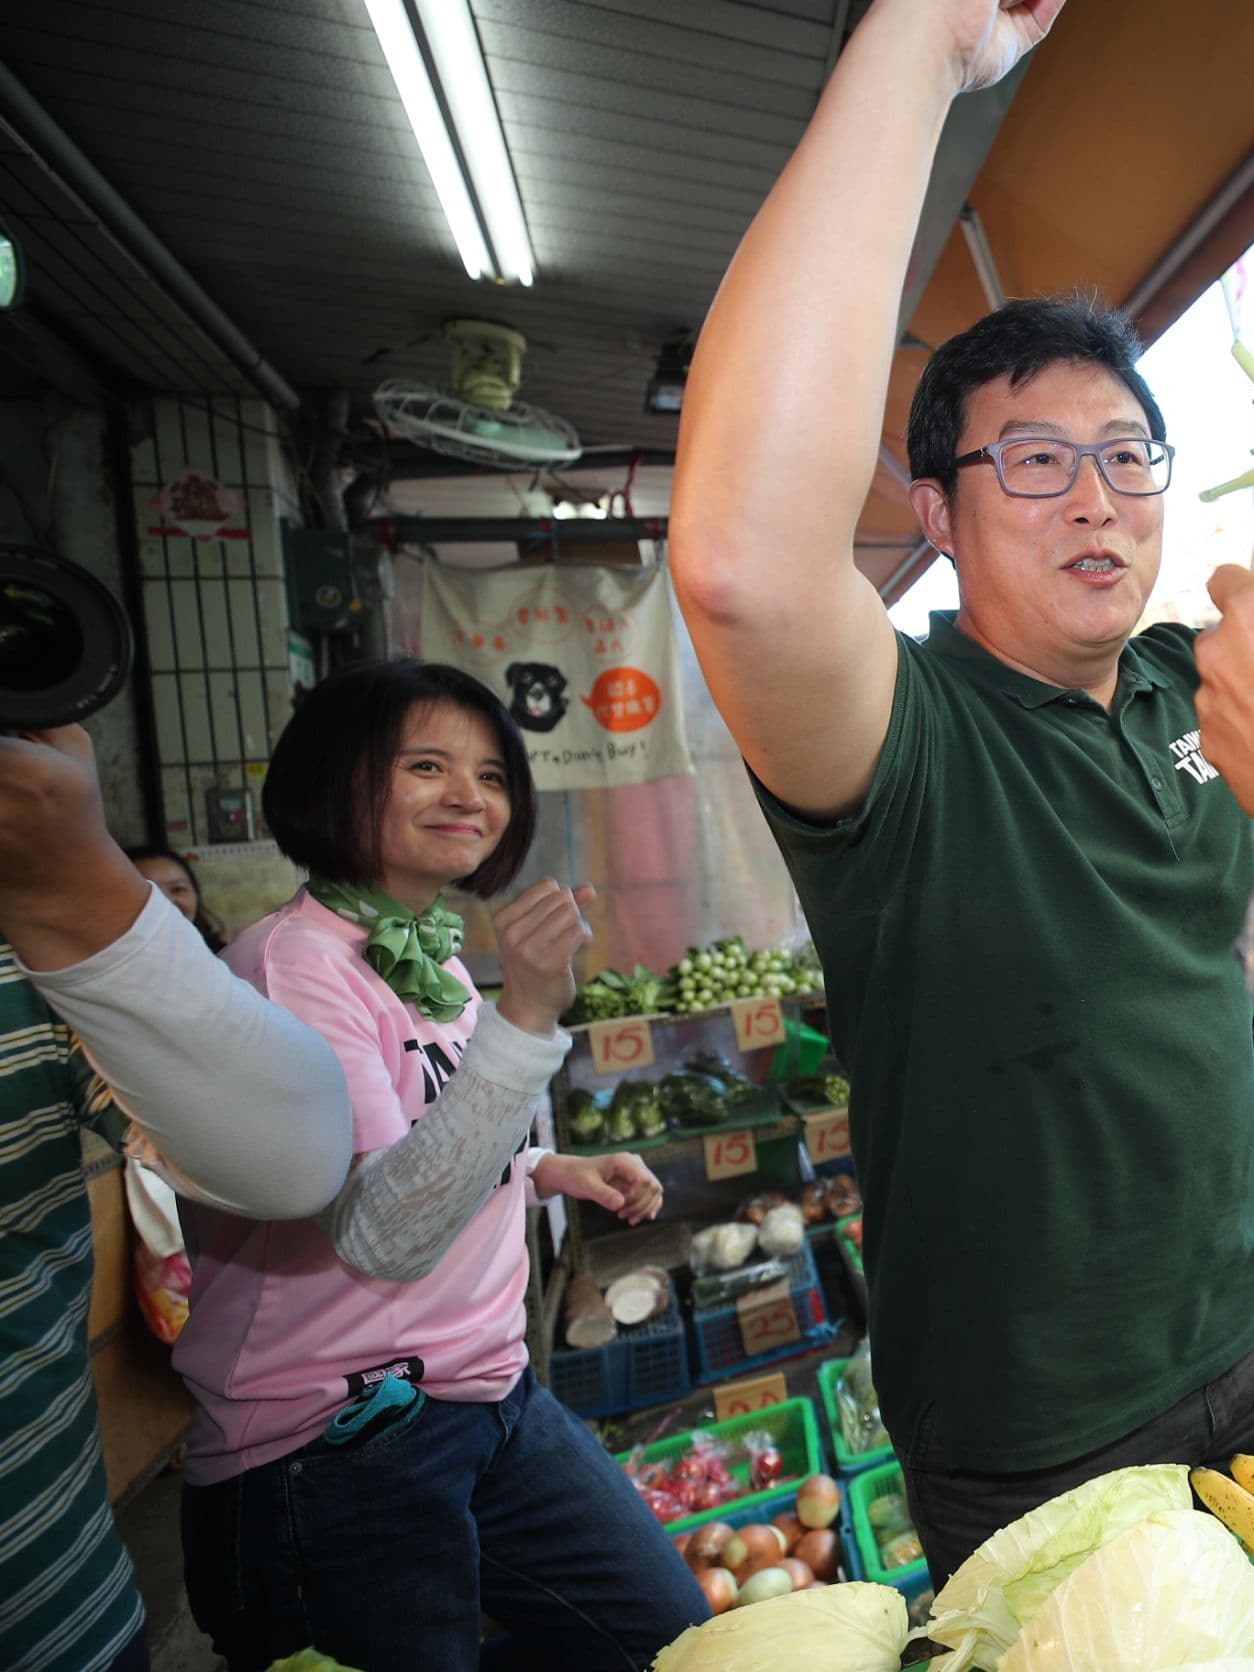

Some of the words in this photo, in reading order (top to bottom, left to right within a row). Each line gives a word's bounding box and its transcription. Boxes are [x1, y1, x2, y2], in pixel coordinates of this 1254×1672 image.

[1169, 730, 1201, 758] TAIW
[745, 1003, 781, 1036] 15
[602, 1025, 645, 1064] 15
[713, 1133, 751, 1166] 15
[748, 1301, 796, 1339] 25
